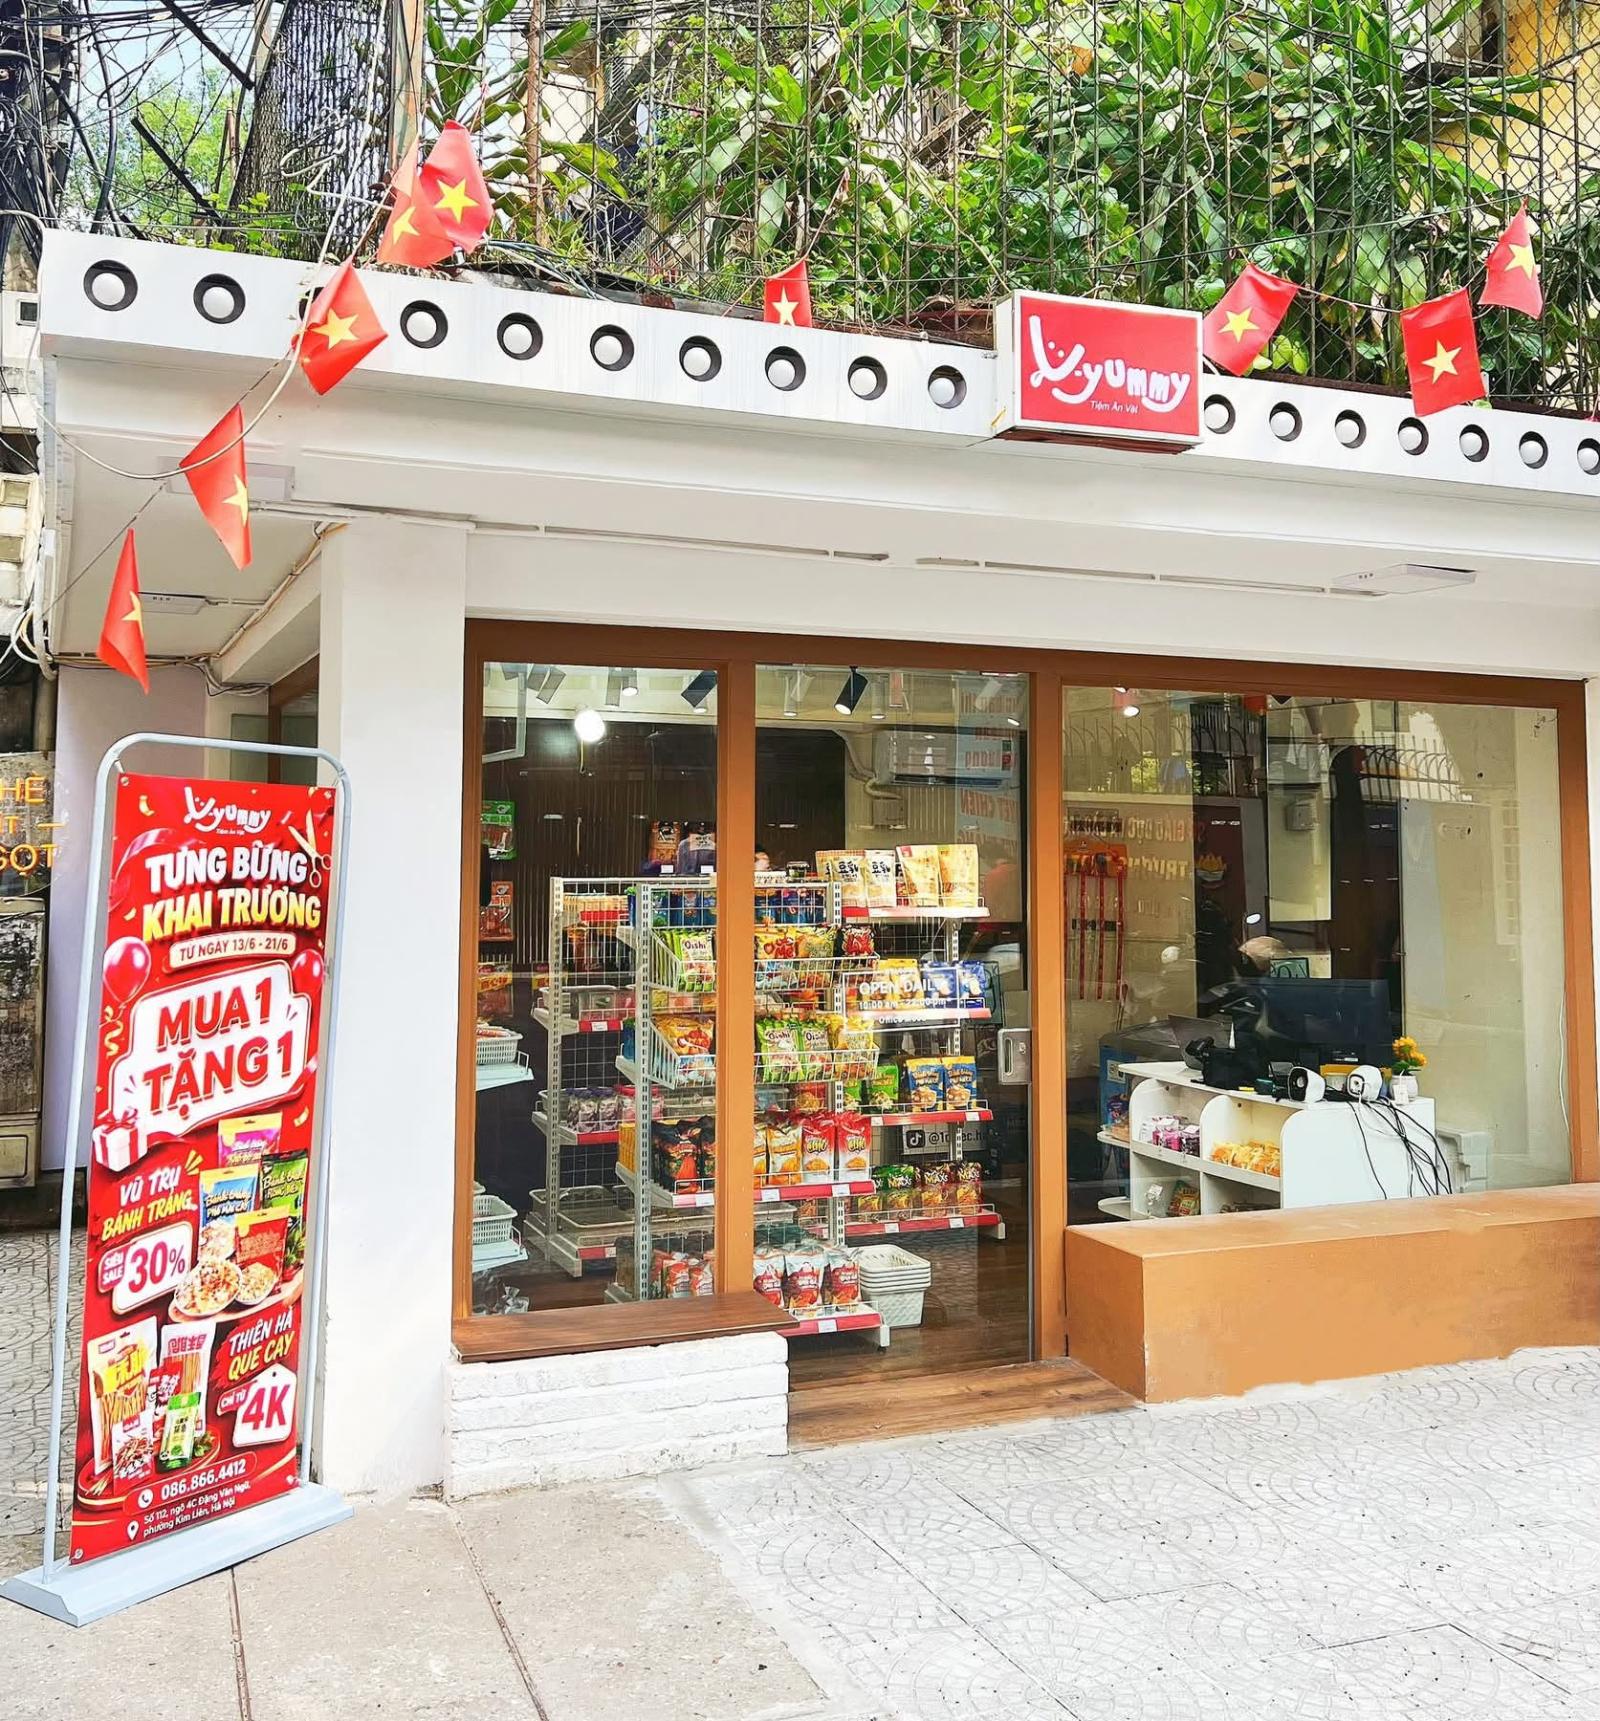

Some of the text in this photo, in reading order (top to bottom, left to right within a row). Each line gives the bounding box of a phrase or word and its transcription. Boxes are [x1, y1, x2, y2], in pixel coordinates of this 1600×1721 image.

[145, 840, 308, 893] TƯNG BỪNG
[143, 884, 321, 943] KHAI TRƯƠNG
[199, 936, 230, 955] NGÀY
[233, 937, 256, 952] 13/6
[265, 937, 288, 950] 21/6
[684, 939, 706, 950] Oishi
[859, 980, 897, 996] OPEN
[157, 976, 272, 1053] MUA 1
[767, 1030, 790, 1041] Oishi
[142, 1030, 293, 1120] TẶNG 1
[121, 1165, 181, 1207] VŨ TRỤ
[101, 1206, 144, 1241] BÁNH
[147, 1188, 193, 1223] TRÁNG
[102, 1265, 124, 1285] SALE
[128, 1241, 186, 1293] 30%
[229, 1318, 273, 1357] THIÊN
[275, 1306, 293, 1335] HÀ
[228, 1330, 295, 1381] QUE CAY
[241, 1384, 291, 1430] 4K
[161, 1458, 247, 1500] 086.866.4412
[175, 1514, 190, 1526] Kim
[211, 1502, 221, 1513] Hà
[187, 1498, 198, 1508] 4C
